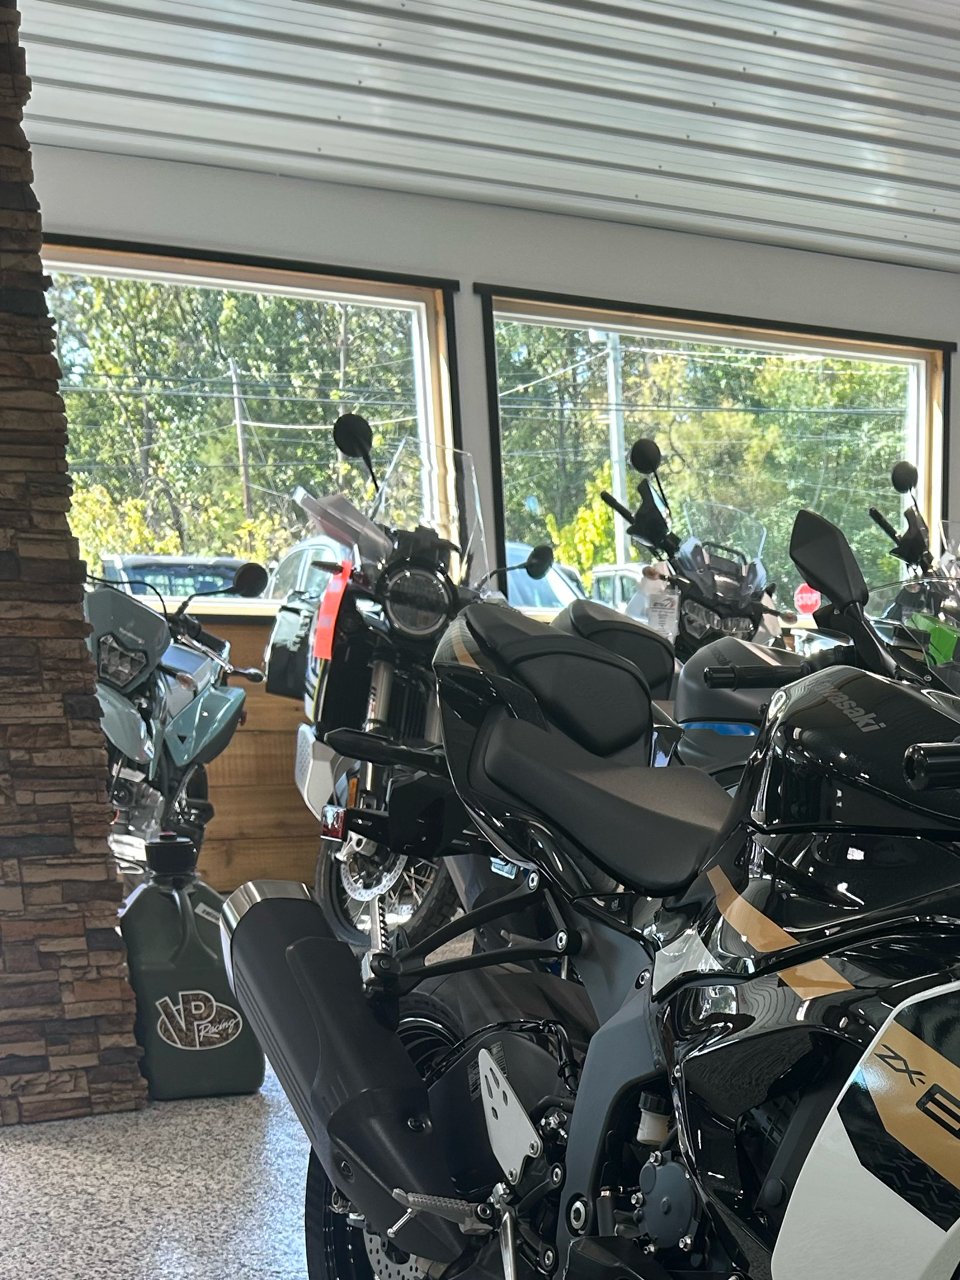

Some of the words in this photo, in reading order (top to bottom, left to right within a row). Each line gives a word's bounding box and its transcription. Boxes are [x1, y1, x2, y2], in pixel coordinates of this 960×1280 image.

[796, 592, 819, 606] STOP
[155, 989, 216, 1050] VP
[199, 1018, 238, 1041] Racing
